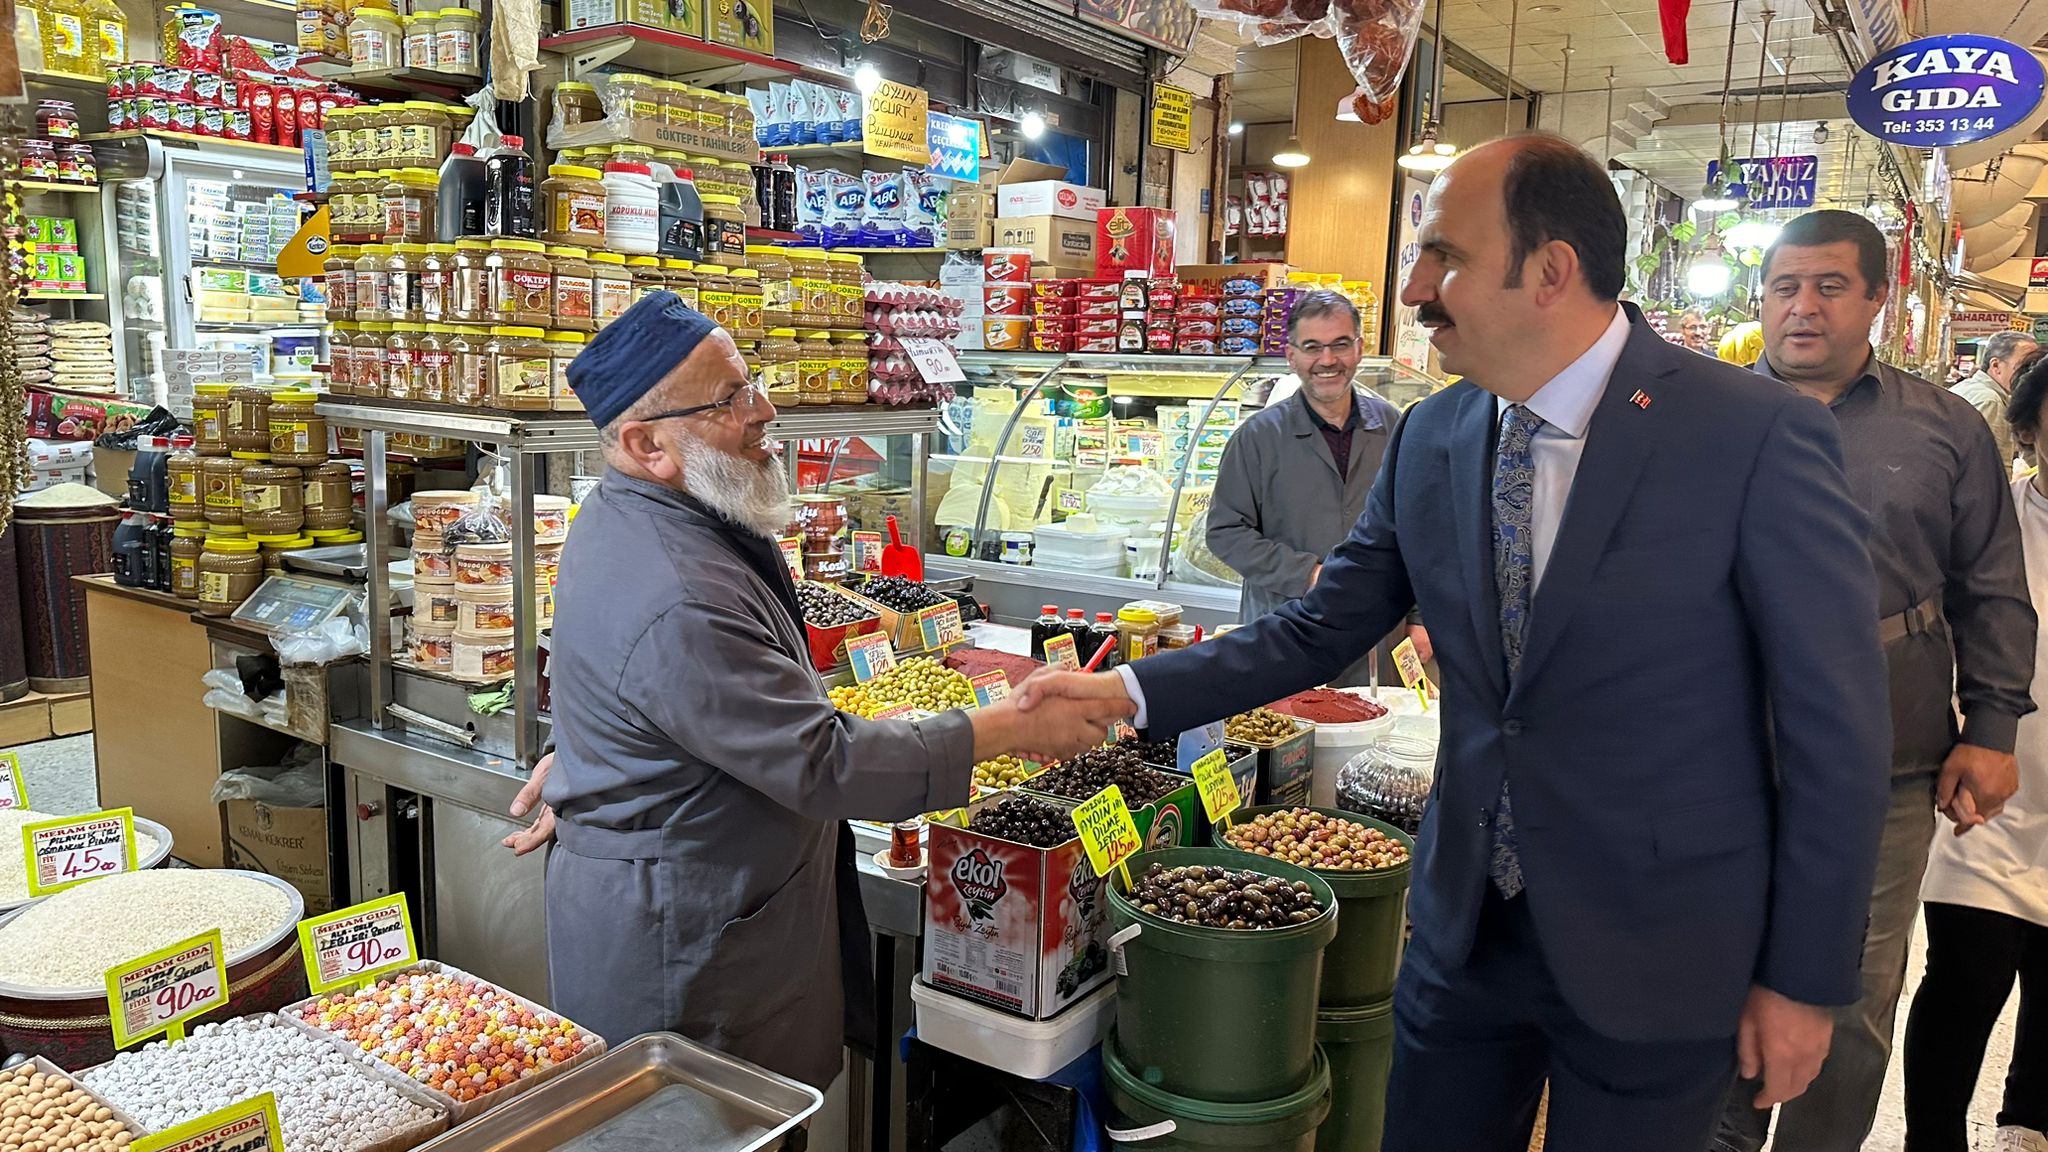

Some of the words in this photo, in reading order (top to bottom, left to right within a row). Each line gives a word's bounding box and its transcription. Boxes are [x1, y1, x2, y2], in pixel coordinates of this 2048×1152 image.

[1871, 47, 2018, 91] KAYA
[1881, 86, 2001, 112] GIDA
[1883, 120, 1911, 134] Tel:
[1915, 119, 1945, 132] 353
[1950, 119, 1969, 132] 13
[1973, 117, 1994, 131] 44
[656, 127, 699, 146] GÖKTEPE
[873, 189, 898, 204] ABC
[514, 272, 551, 284] GÖKTEP
[1150, 293, 1173, 301] sarelle
[1148, 333, 1171, 341] sarelle
[38, 825, 86, 840] MERAM
[88, 819, 121, 831] GIDA
[955, 856, 1000, 888] ekol
[1072, 862, 1094, 888] eko
[963, 882, 995, 901] Zeytin
[317, 917, 363, 935] MERAM
[366, 908, 398, 921] GIDA
[124, 959, 174, 984] MERAM
[177, 946, 210, 962] GIDA
[164, 1132, 217, 1152] ERAM
[219, 1117, 261, 1137] GIDA
